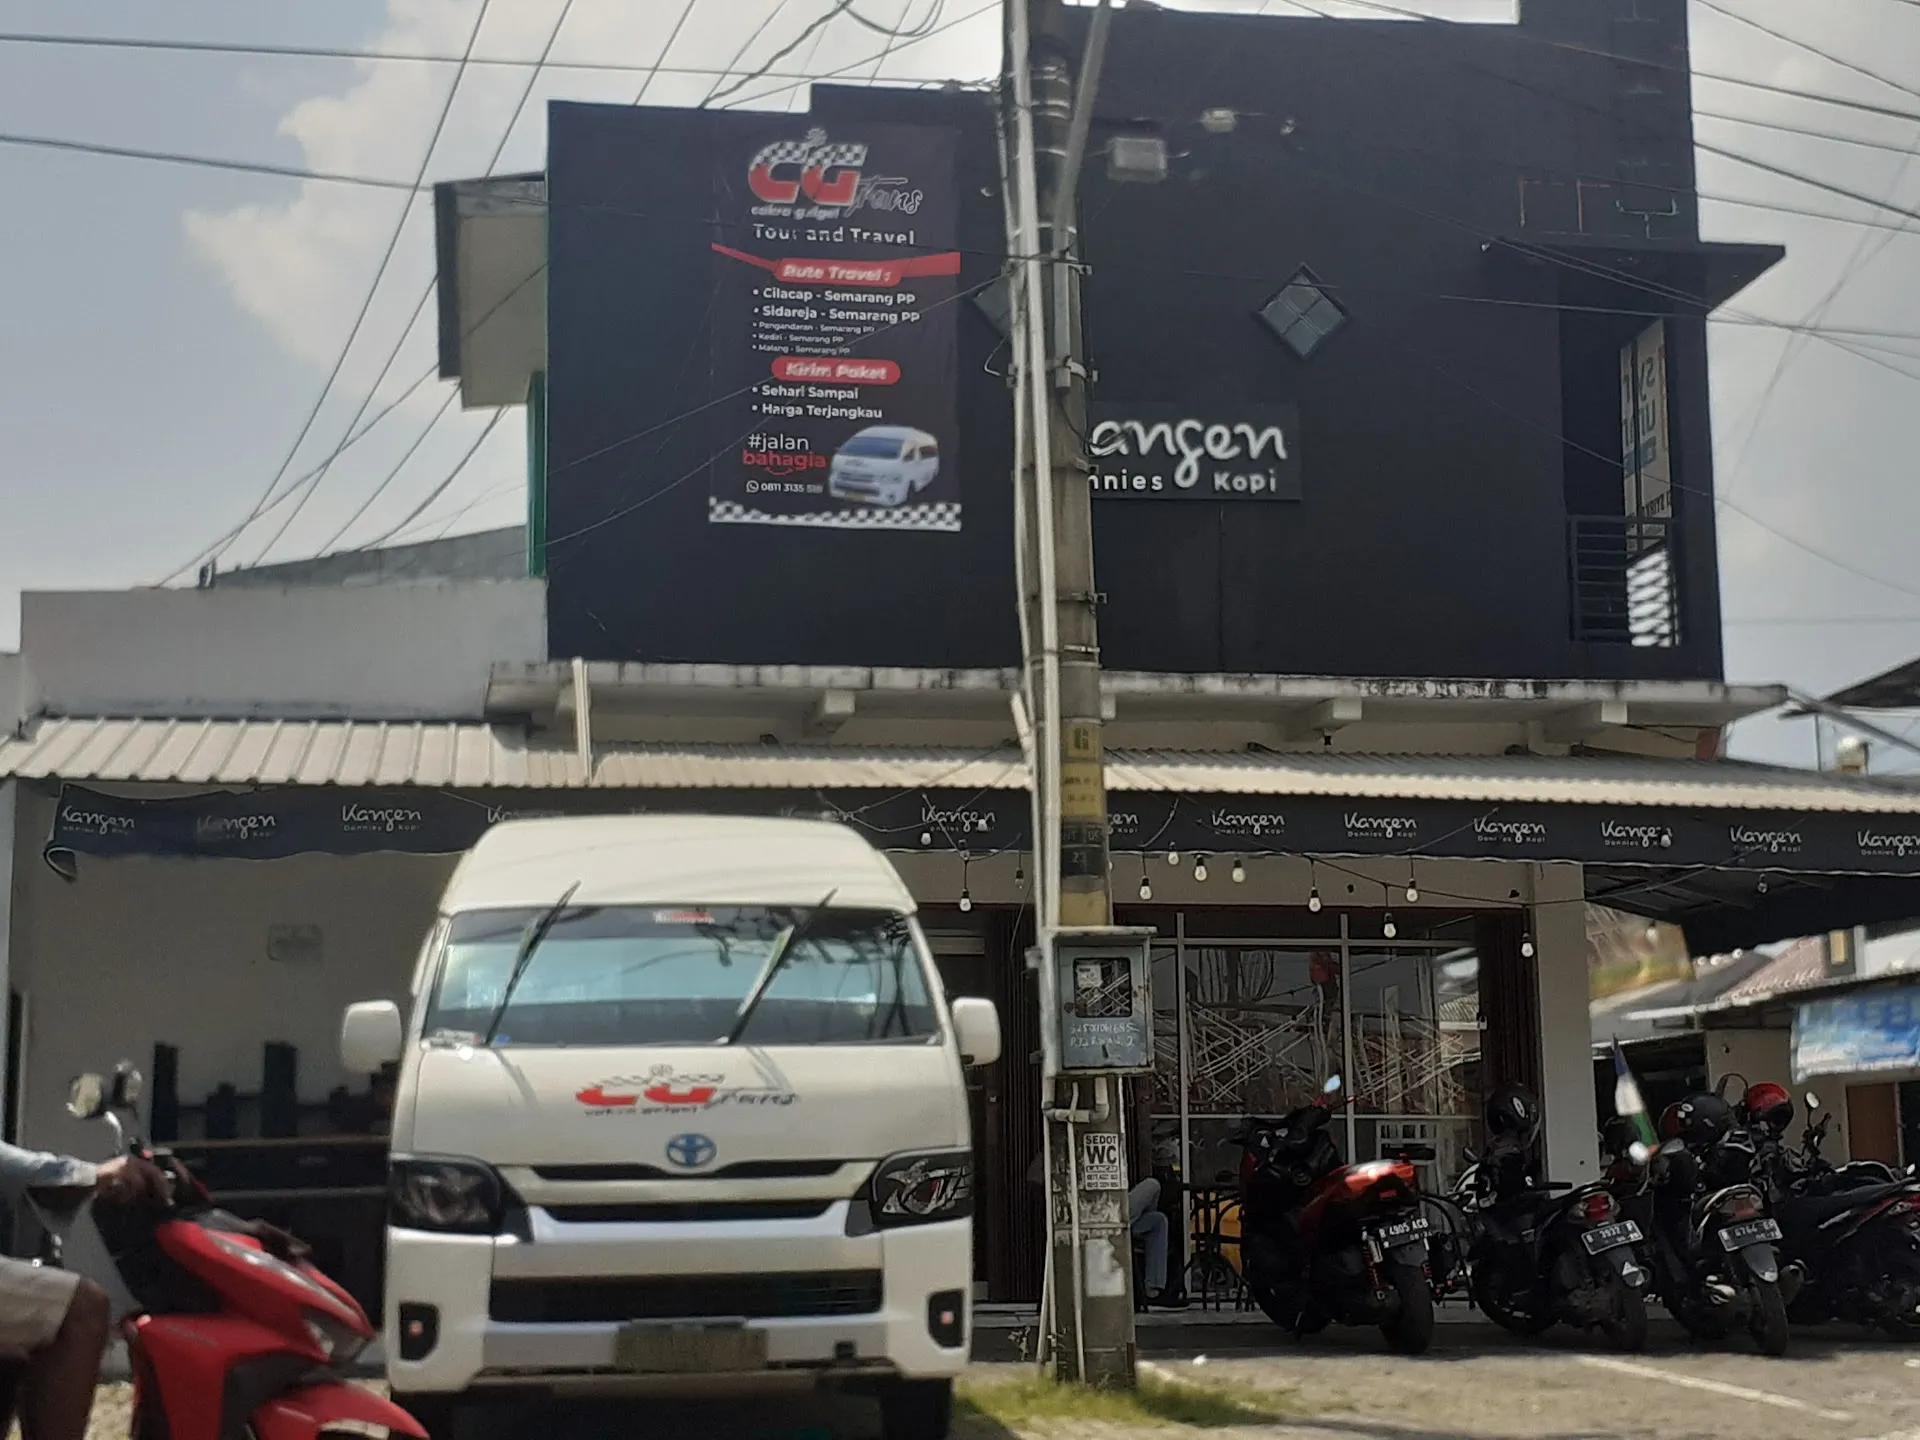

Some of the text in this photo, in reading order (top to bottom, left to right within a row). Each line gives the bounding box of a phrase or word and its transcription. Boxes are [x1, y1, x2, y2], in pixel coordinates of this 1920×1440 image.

[752, 223, 915, 245] Tour and Travel
[763, 287, 813, 302] Cilacap
[824, 290, 893, 306] Semarang
[896, 293, 916, 304] PP
[762, 305, 817, 320] Sidareja
[829, 308, 898, 324] Semarang
[901, 312, 920, 322] PP
[786, 362, 888, 380] Kirim Paket
[762, 384, 859, 400] Sehari Sampai
[762, 403, 883, 419] Harga Terjangkau
[748, 432, 809, 452] #jalan
[743, 450, 828, 470] bahagia
[1089, 419, 1287, 488] angen
[1087, 468, 1277, 493] nnies Kopi
[342, 803, 422, 832] Kangen
[1211, 808, 1285, 835] Kangen
[1344, 812, 1417, 838] Kangen
[1474, 816, 1546, 843] Kangen
[1730, 825, 1802, 852] Kangen
[1086, 1135, 1117, 1145] SEDOT
[1086, 1145, 1117, 1165] WC
